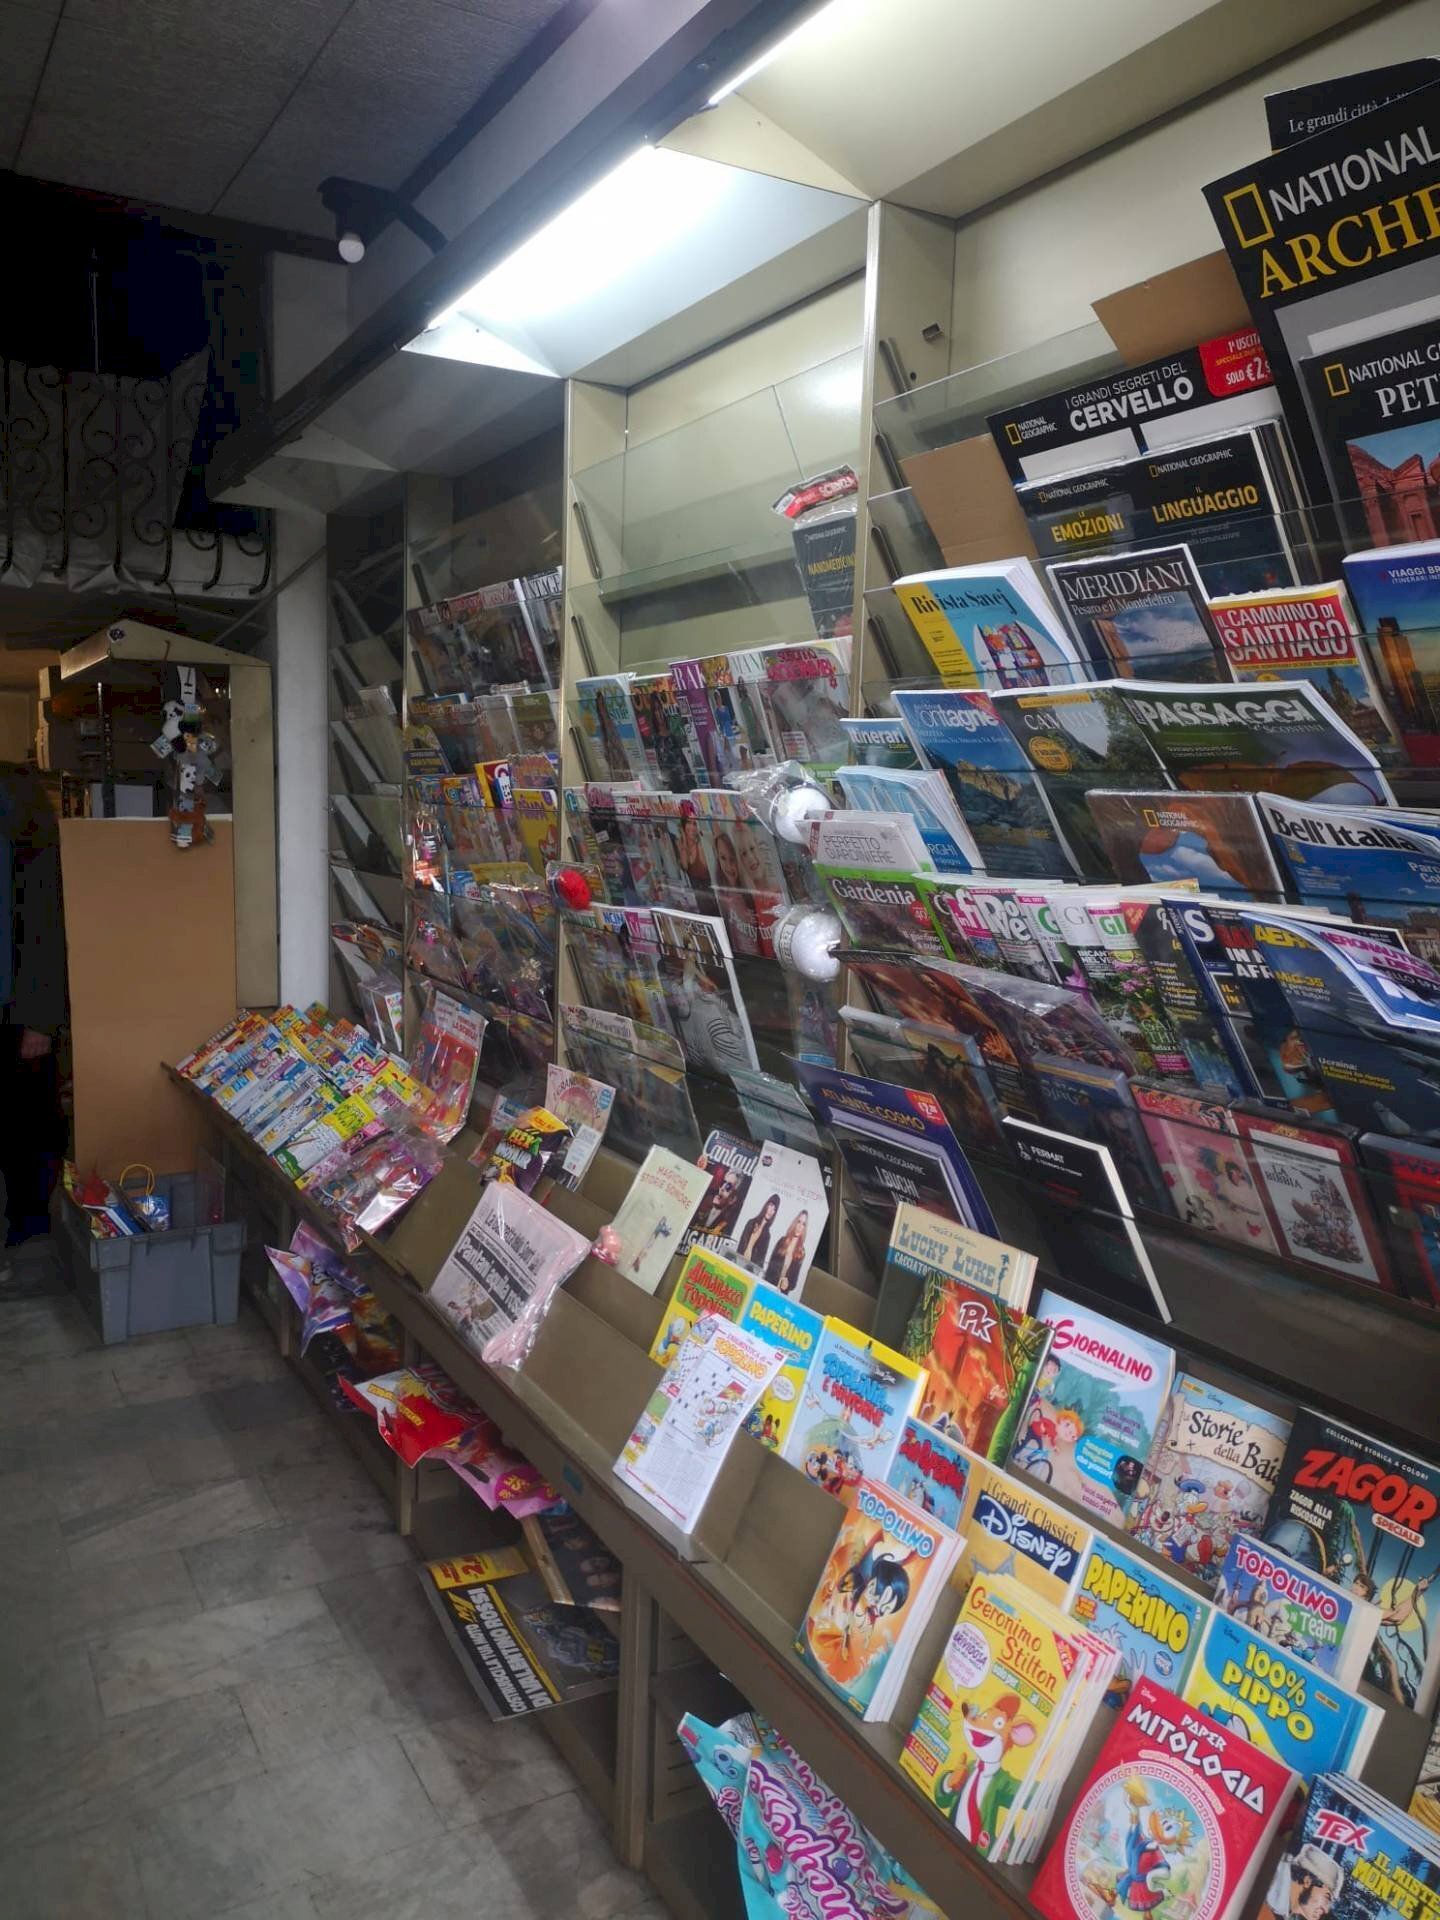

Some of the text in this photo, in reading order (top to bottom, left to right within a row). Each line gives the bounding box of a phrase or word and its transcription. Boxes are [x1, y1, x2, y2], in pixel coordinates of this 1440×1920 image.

[1289, 119, 1304, 134] Le
[1307, 107, 1349, 134] grandi
[1268, 126, 1440, 222] NATIONAL
[1071, 386, 1112, 407] GRANDI
[1112, 369, 1161, 395] SEGRETI
[1162, 361, 1188, 379] DEL
[1226, 371, 1245, 385] SOLO
[1348, 350, 1425, 384] NATIONAL
[1018, 416, 1048, 431] NATIONAL
[1069, 376, 1194, 432] CERVELLO
[1020, 422, 1058, 440] GEOGRAPHIC
[1157, 448, 1233, 474] NATIONAL GEOGRAPHIC
[1046, 477, 1110, 501] NATIONAL GEOGRAPHIC
[1152, 484, 1259, 523] LINGUAGGIO
[1051, 511, 1125, 544] EMOZIONI
[1060, 560, 1192, 602] MERIDIANI
[1389, 568, 1426, 579] VIAGGI
[910, 587, 1018, 616] Rivista Savej
[1071, 601, 1099, 617] Pesaro
[1117, 594, 1176, 612] Montefeltro
[1217, 602, 1335, 629] IL CAMMINO DI
[1224, 619, 1349, 662] SANTIAGO
[1136, 699, 1316, 735] PASSAGGI
[1157, 810, 1188, 821] NATIONAL
[1268, 807, 1424, 853] Bell'Italia
[832, 877, 917, 906] Gardenia
[641, 1172, 666, 1193] STORIE
[456, 1234, 496, 1279] Pantani
[899, 1222, 949, 1266] LUCKY
[953, 1245, 997, 1287] LUKE
[750, 1299, 813, 1351] PAPERINO
[1188, 1410, 1244, 1447] Storie
[1213, 1443, 1240, 1465] della
[1325, 1427, 1363, 1453] COLLEZIONE
[1364, 1445, 1392, 1465] STORICA
[1401, 1463, 1429, 1481] COLORI
[1290, 1488, 1332, 1520] ZAGOR ALLA
[1293, 1448, 1438, 1531] ZAGOR
[857, 1490, 935, 1559] TOPOLINO
[993, 1483, 1031, 1517] Grandi
[1031, 1503, 1078, 1548] Classici
[1289, 1504, 1325, 1531] RISCOSSA!
[1375, 1516, 1421, 1546] SPECIALE
[1236, 1544, 1339, 1623] TOPOLINO
[970, 1585, 1042, 1653] Geronimo
[1082, 1553, 1191, 1655] PAPERINO
[464, 1620, 488, 1646] MOTO
[1299, 1611, 1337, 1643] Team
[466, 1585, 553, 1709] DI VALENTINO ROSSI
[1001, 1635, 1058, 1693] Stilton
[1244, 1640, 1307, 1707] 100%
[1222, 1659, 1315, 1742] PIPPO
[1181, 1714, 1228, 1753] PAPER
[1127, 1704, 1266, 1815] MITOLOGIA
[1313, 1808, 1376, 1854] TEX
